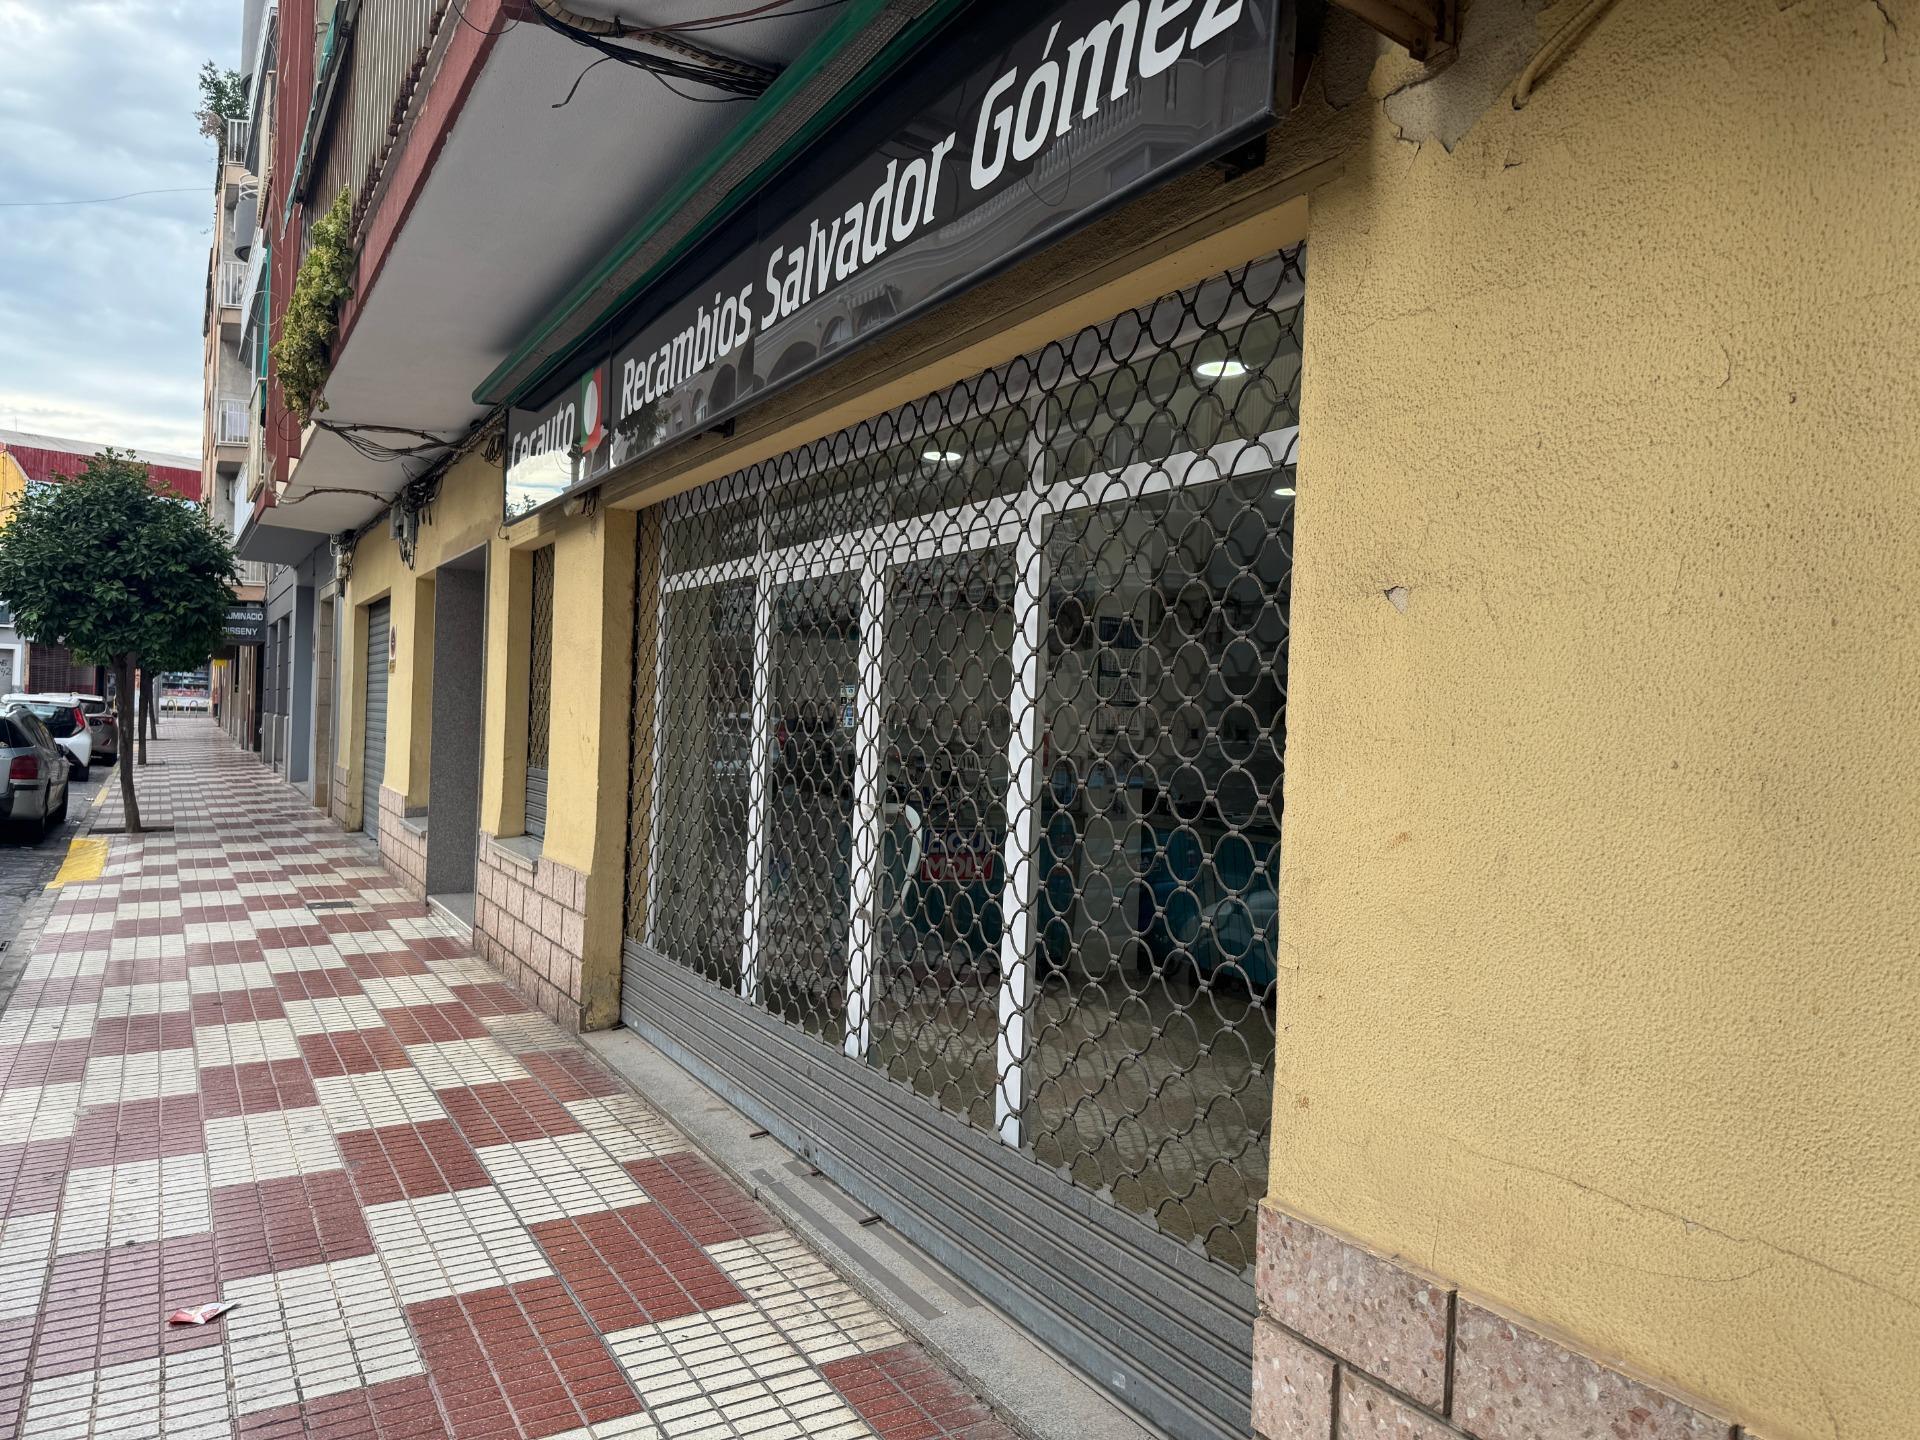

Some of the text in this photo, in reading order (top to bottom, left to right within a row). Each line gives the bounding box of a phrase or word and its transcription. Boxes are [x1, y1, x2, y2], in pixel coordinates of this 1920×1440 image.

[620, 283, 753, 420] Recambios
[760, 131, 956, 331] Salvador
[925, 856, 993, 878] MOLY
